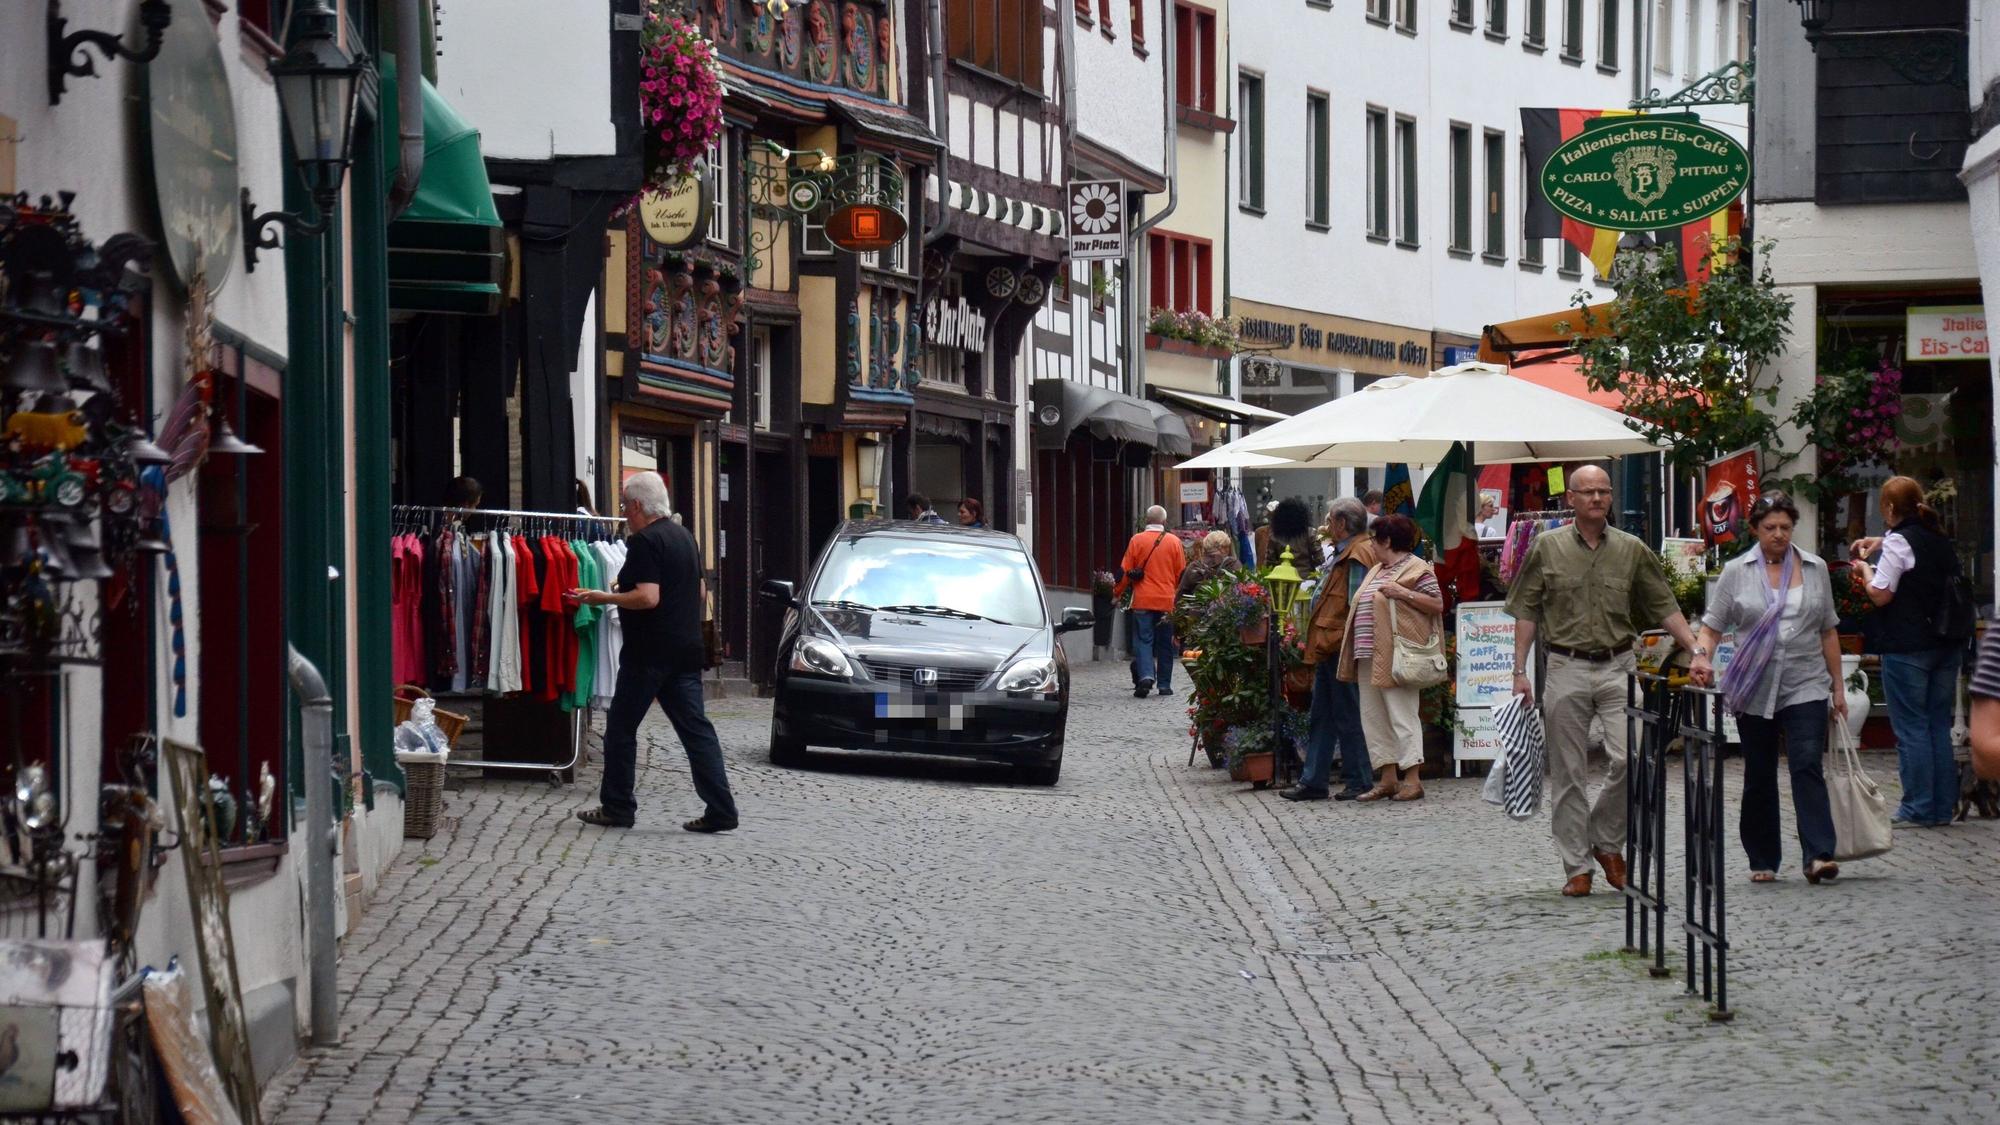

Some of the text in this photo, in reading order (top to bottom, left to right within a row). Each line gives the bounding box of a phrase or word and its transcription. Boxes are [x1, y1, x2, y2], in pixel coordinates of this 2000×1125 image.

[1560, 126, 1729, 166] Italienisches Eis-Café
[1563, 164, 1729, 185] CARLO PITTAU
[1553, 176, 1740, 223] PIZZA SALATE SUPPEN
[1091, 239, 1120, 251] Platz
